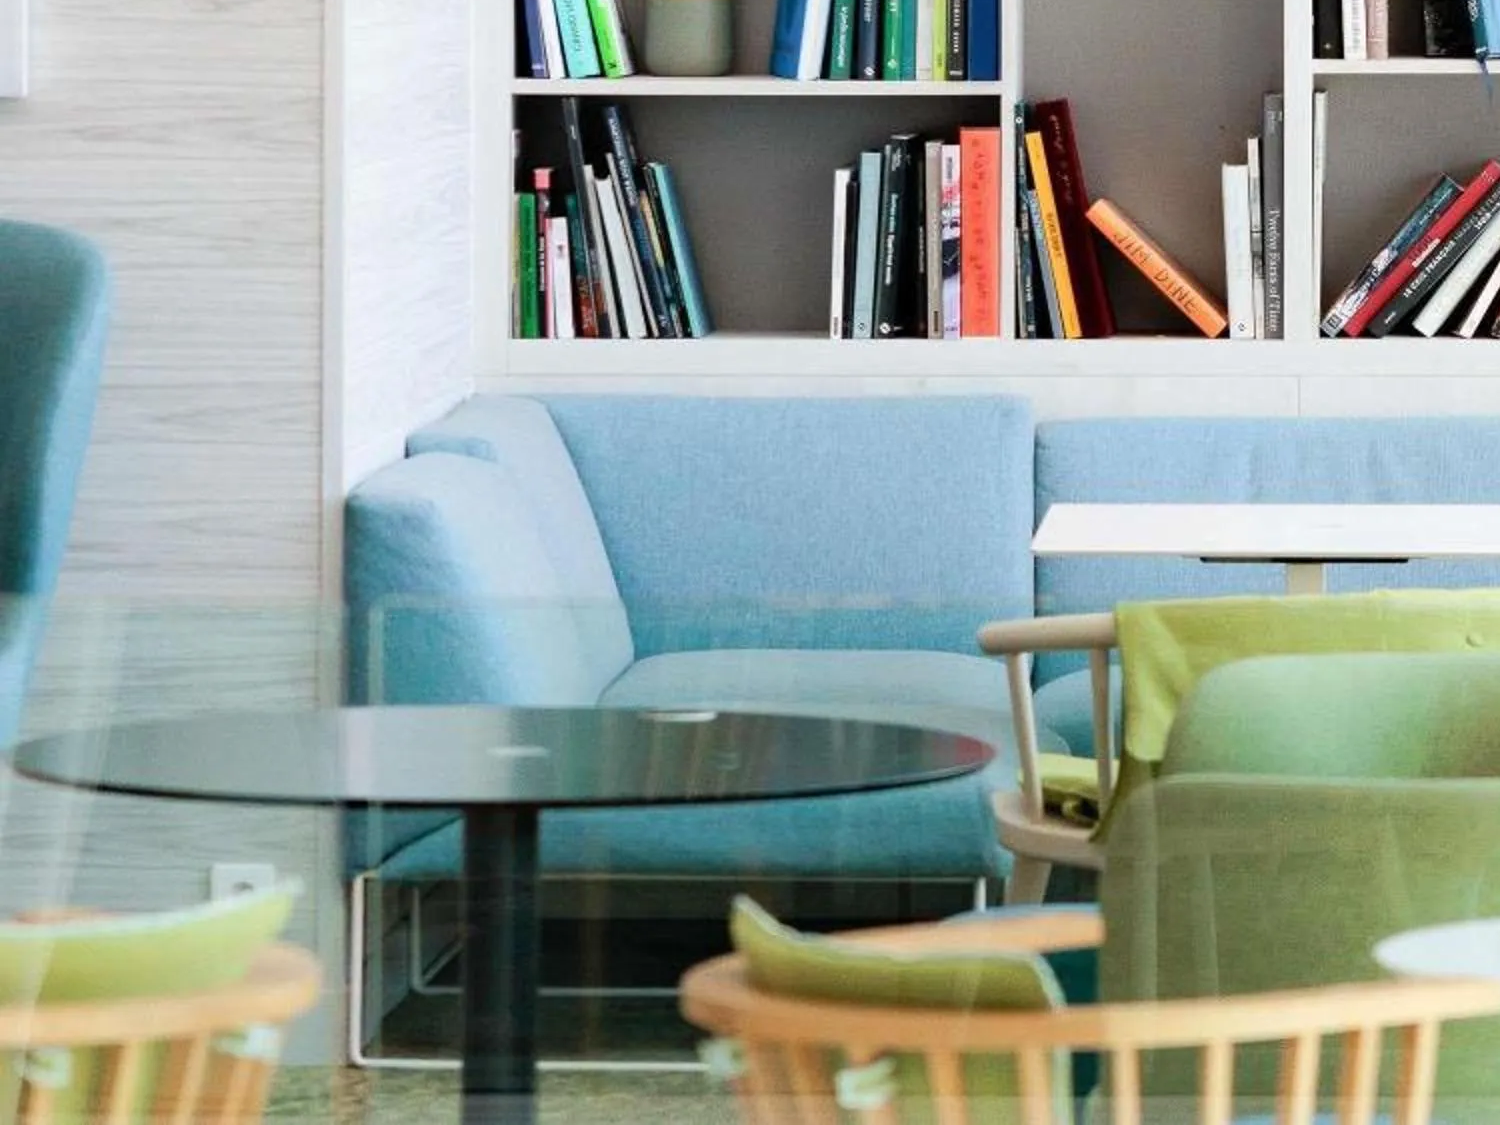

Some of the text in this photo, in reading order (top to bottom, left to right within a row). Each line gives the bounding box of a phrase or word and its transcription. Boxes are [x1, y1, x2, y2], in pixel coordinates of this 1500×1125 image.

[1268, 209, 1281, 249] Twelve
[1112, 233, 1200, 314] JIM DINE
[1269, 283, 1281, 298] of
